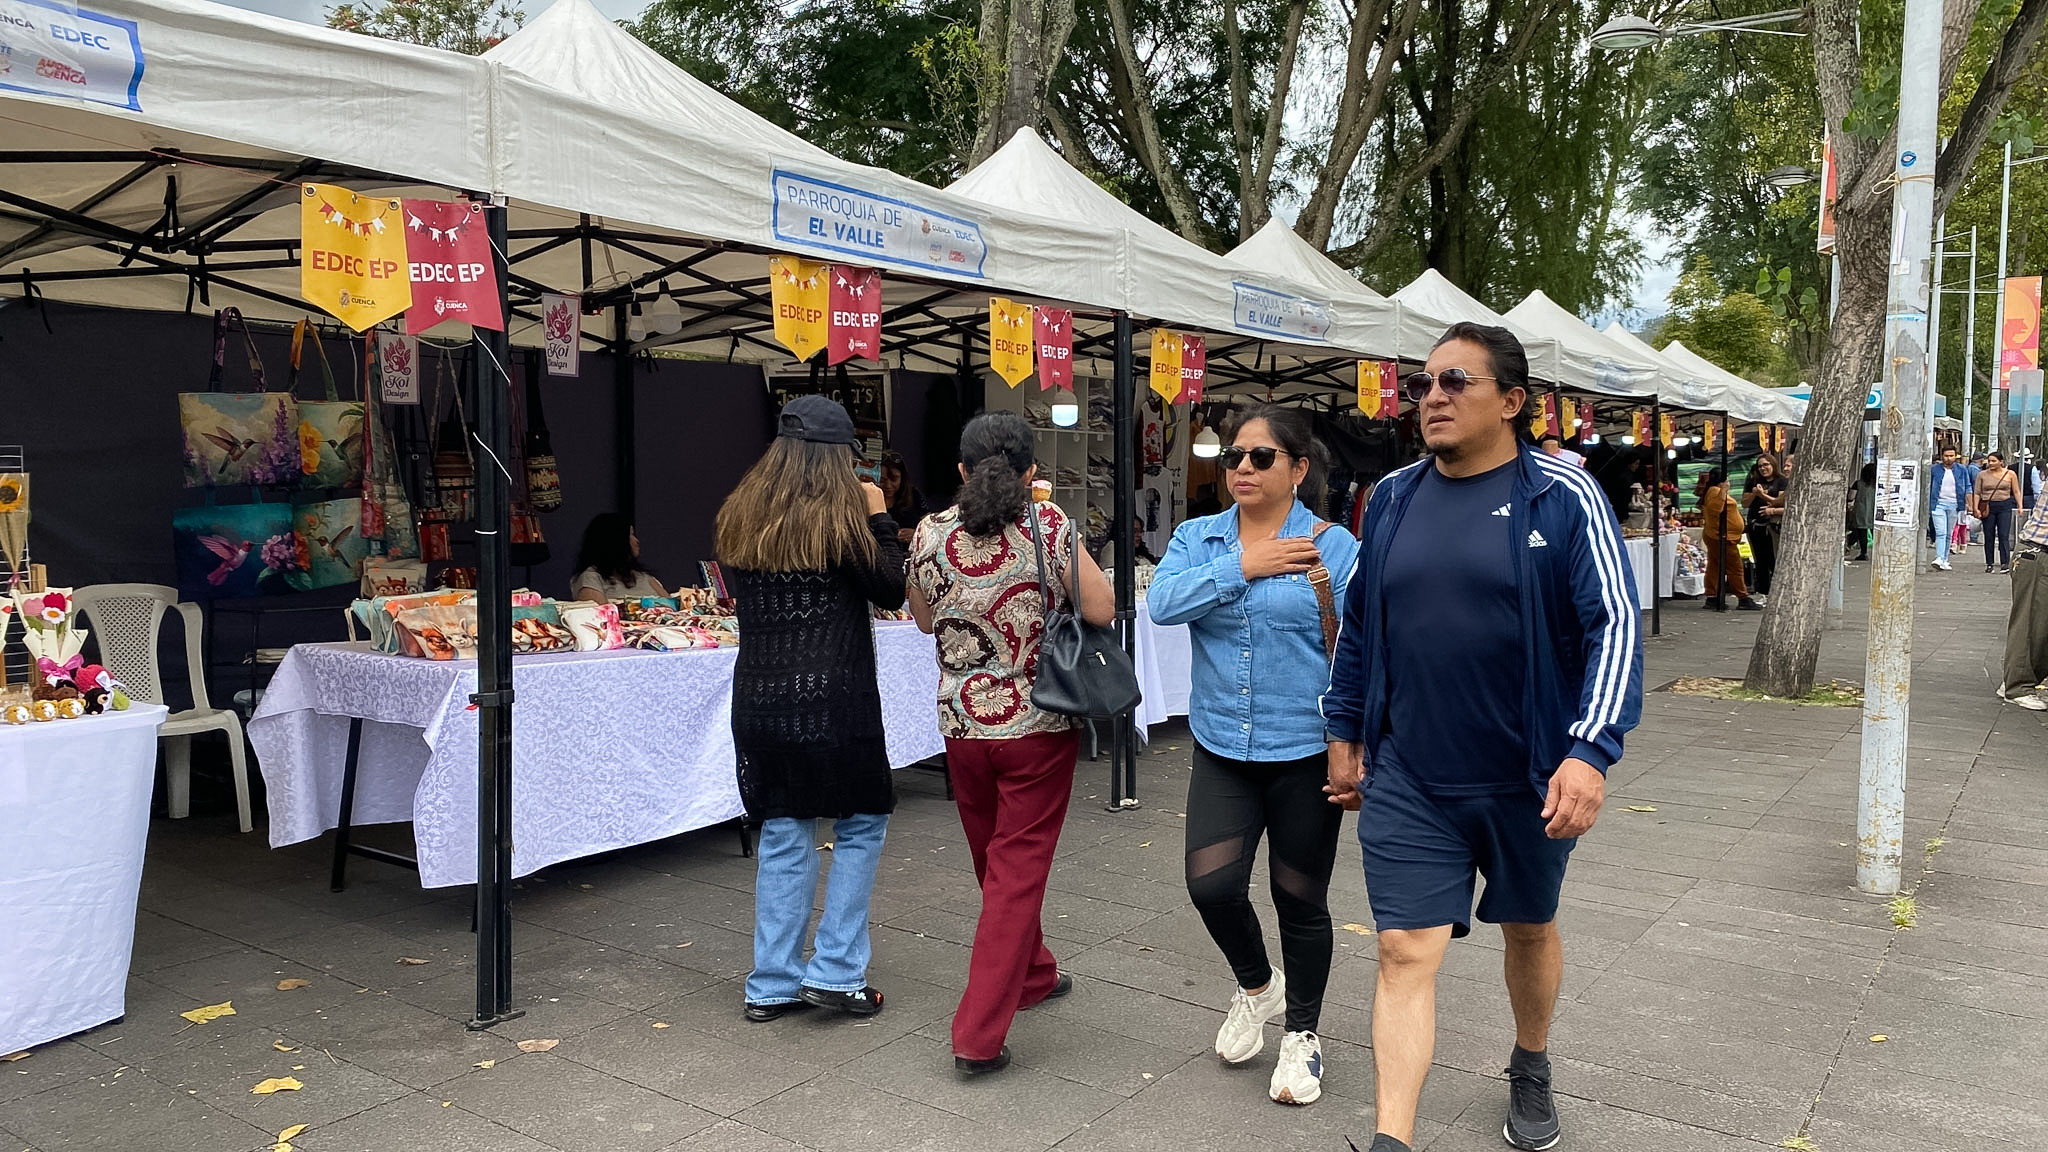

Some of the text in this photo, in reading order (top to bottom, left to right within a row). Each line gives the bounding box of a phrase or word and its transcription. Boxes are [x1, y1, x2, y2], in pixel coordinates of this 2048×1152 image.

[50, 24, 110, 50] EDEC
[787, 185, 902, 228] PARROQUIA DE
[809, 216, 885, 248] EL VALLE
[312, 249, 398, 279] EDEC EP
[408, 262, 486, 283] EDEC EP
[351, 297, 376, 306] CUENCA
[779, 303, 823, 324] EDEC EP
[833, 311, 879, 328] EDEC EP
[1248, 310, 1283, 328] EL VALLE
[546, 342, 570, 360] Koi
[1016, 343, 1029, 356] EP
[1057, 346, 1069, 360] EP
[384, 374, 410, 390] Koi
[1193, 368, 1204, 380] EP
